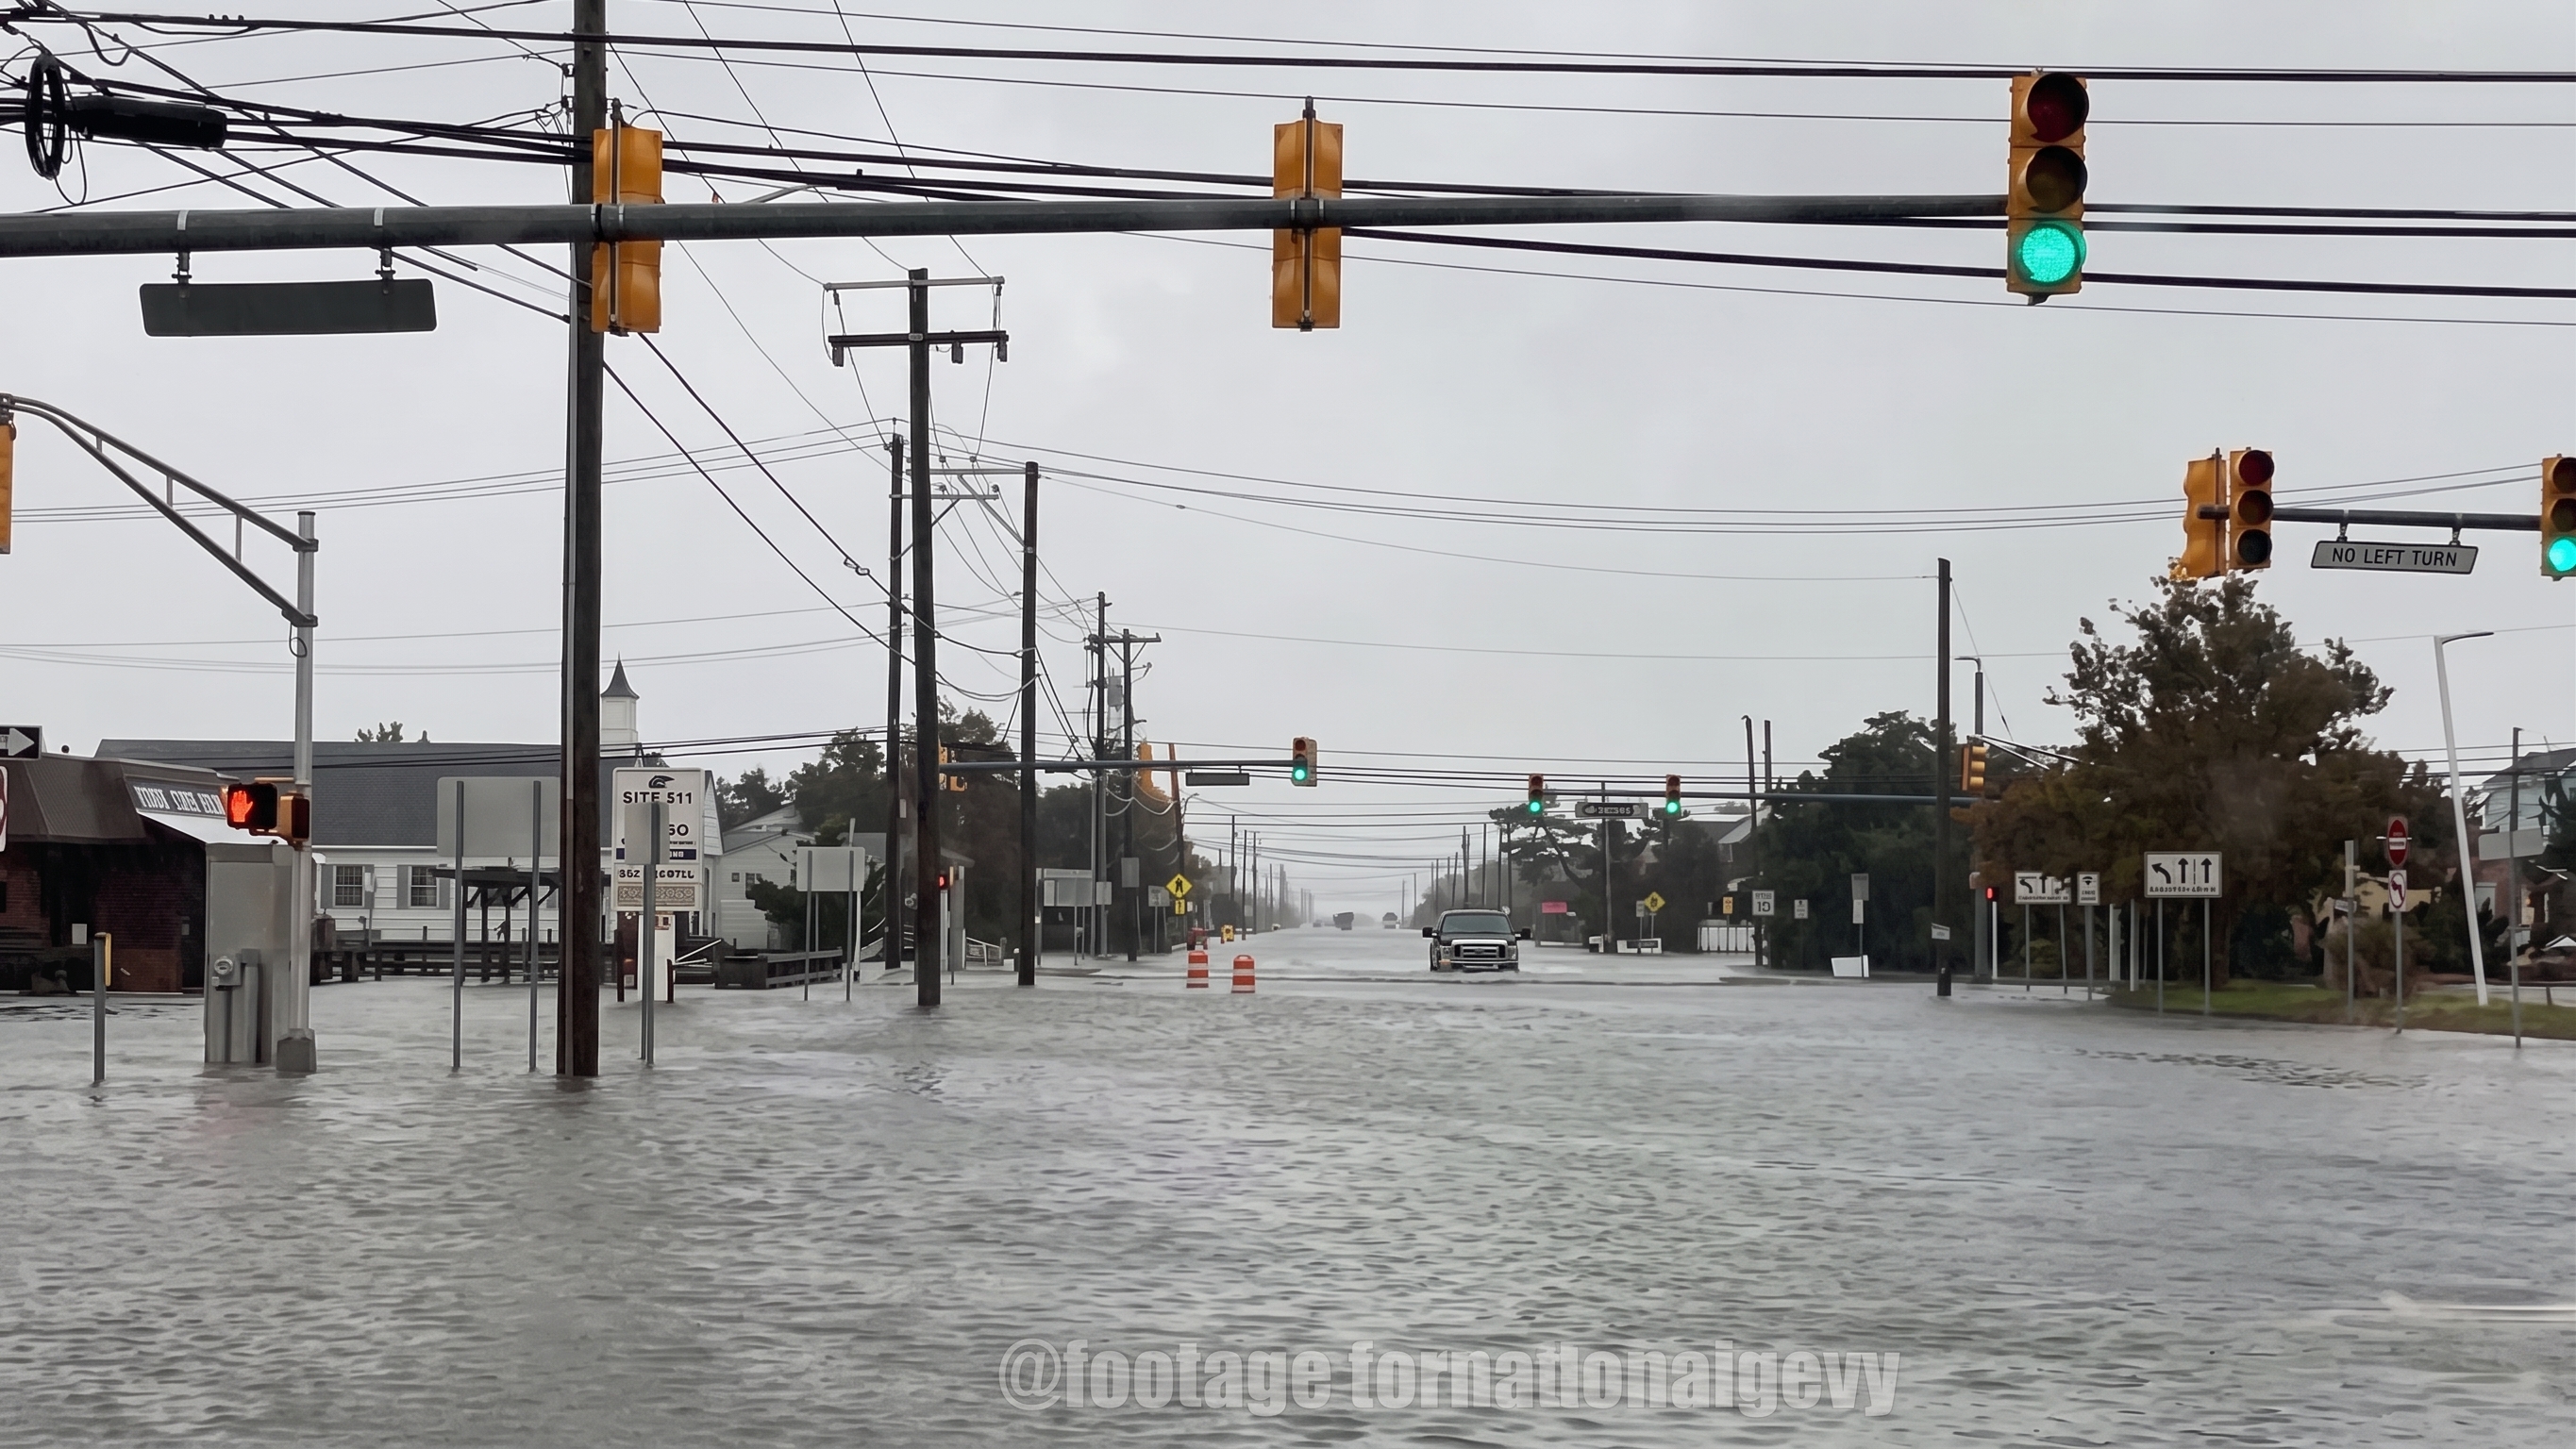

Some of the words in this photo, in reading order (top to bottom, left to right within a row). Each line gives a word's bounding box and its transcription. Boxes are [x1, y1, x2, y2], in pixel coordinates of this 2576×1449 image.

[2332, 547, 2356, 563] NO
[2364, 548, 2406, 565] LEFT
[2412, 550, 2457, 567] TURN
[666, 791, 692, 805] 511
